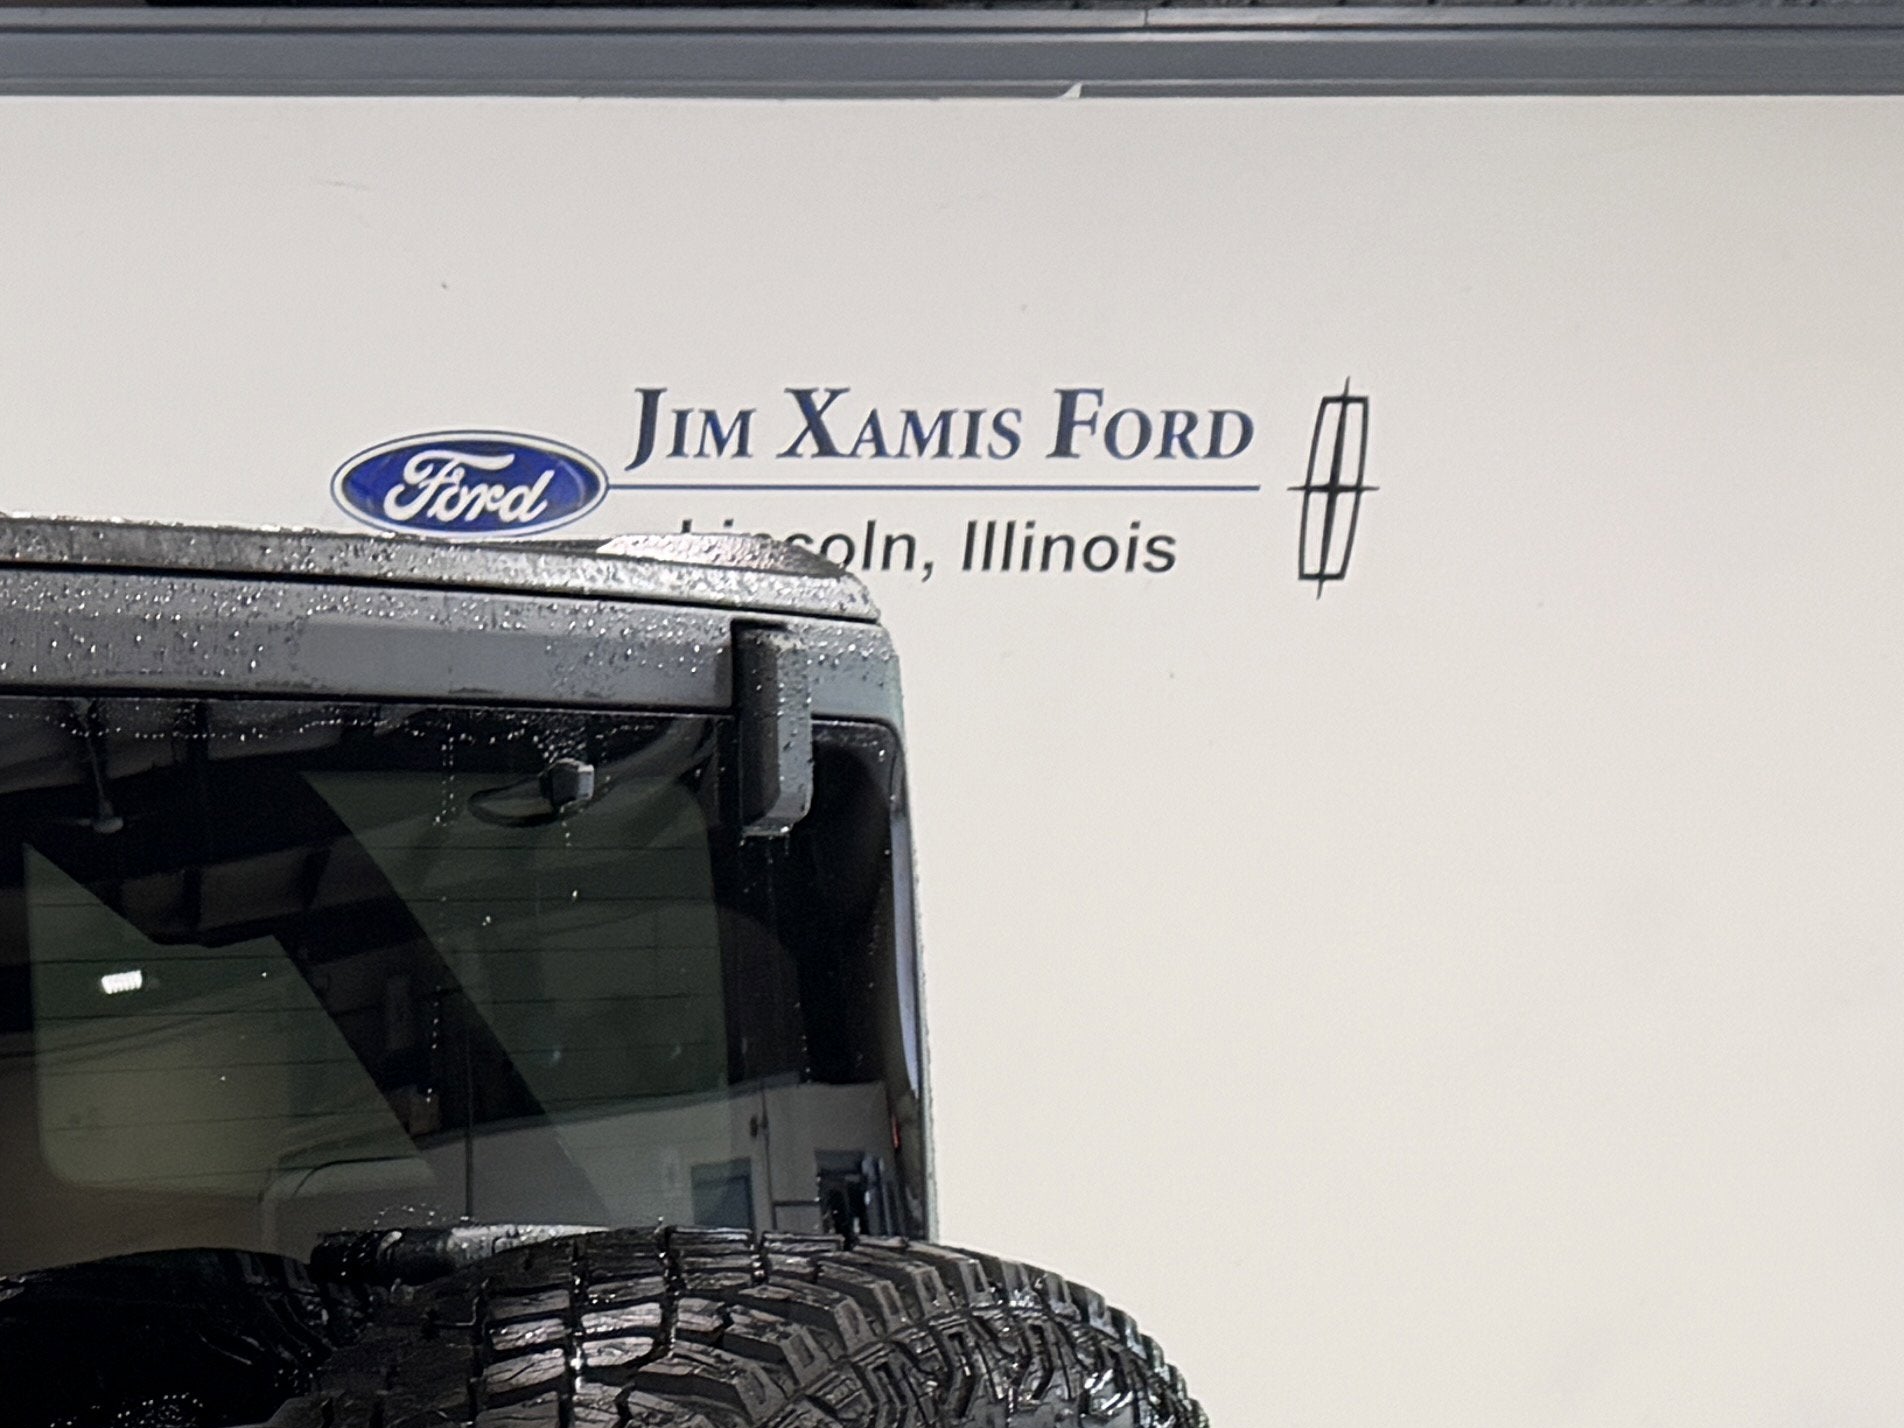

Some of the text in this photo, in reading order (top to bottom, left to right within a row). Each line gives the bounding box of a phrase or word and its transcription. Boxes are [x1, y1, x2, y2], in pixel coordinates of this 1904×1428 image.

[624, 387, 1255, 472] JIM XAMIS FORD
[962, 520, 1177, 573] Illinois
